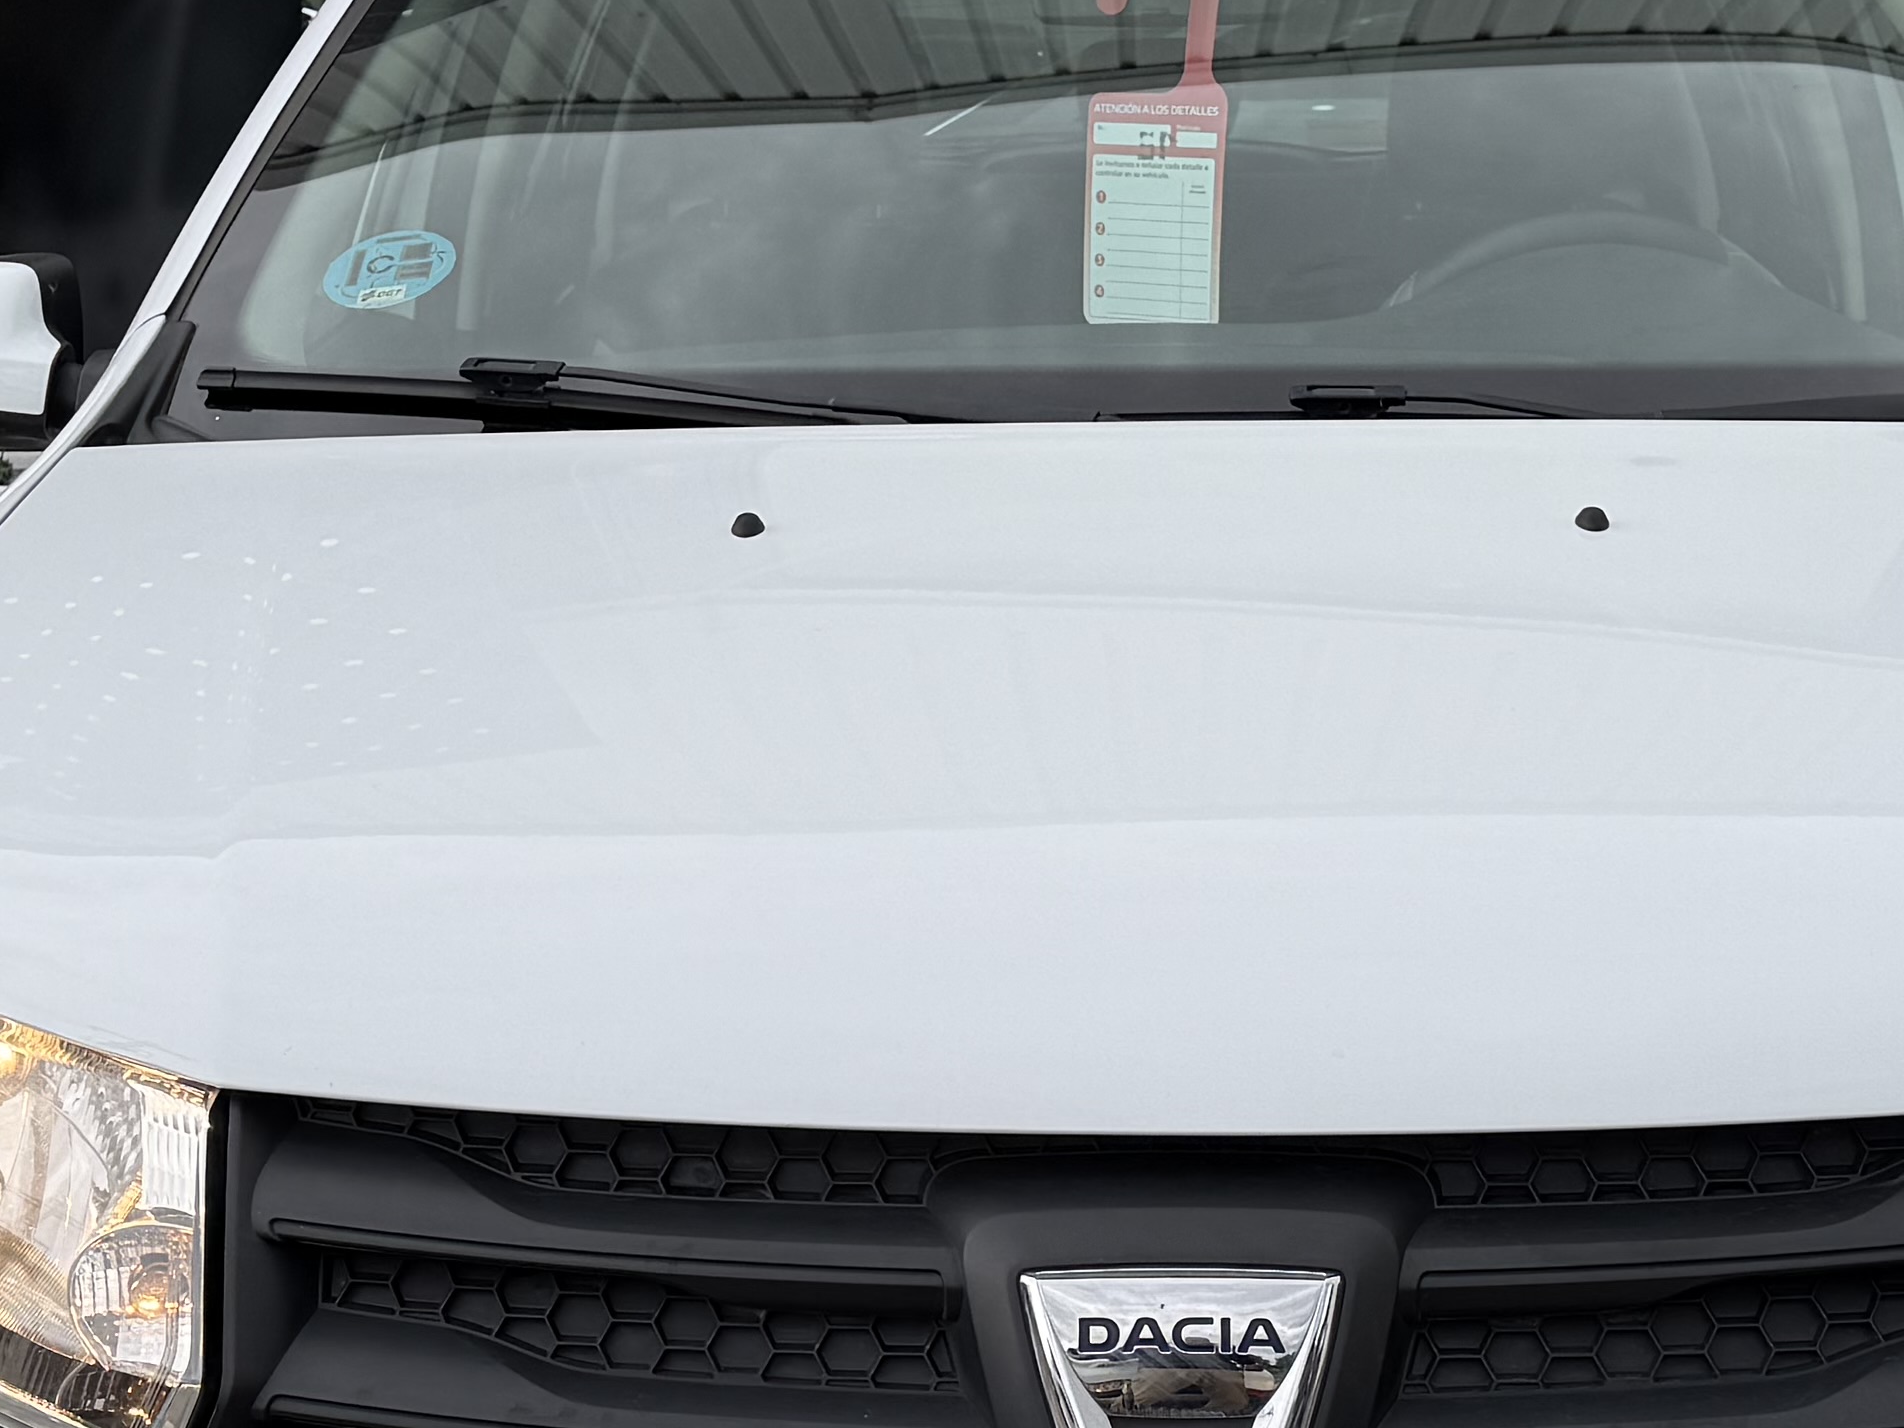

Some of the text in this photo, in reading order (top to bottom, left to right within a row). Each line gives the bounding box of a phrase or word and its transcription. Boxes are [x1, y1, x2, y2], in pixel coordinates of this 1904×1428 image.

[1093, 103, 1220, 117] ATENCIÓN A LOS DETALLES
[1077, 1317, 1286, 1354] DACIA
